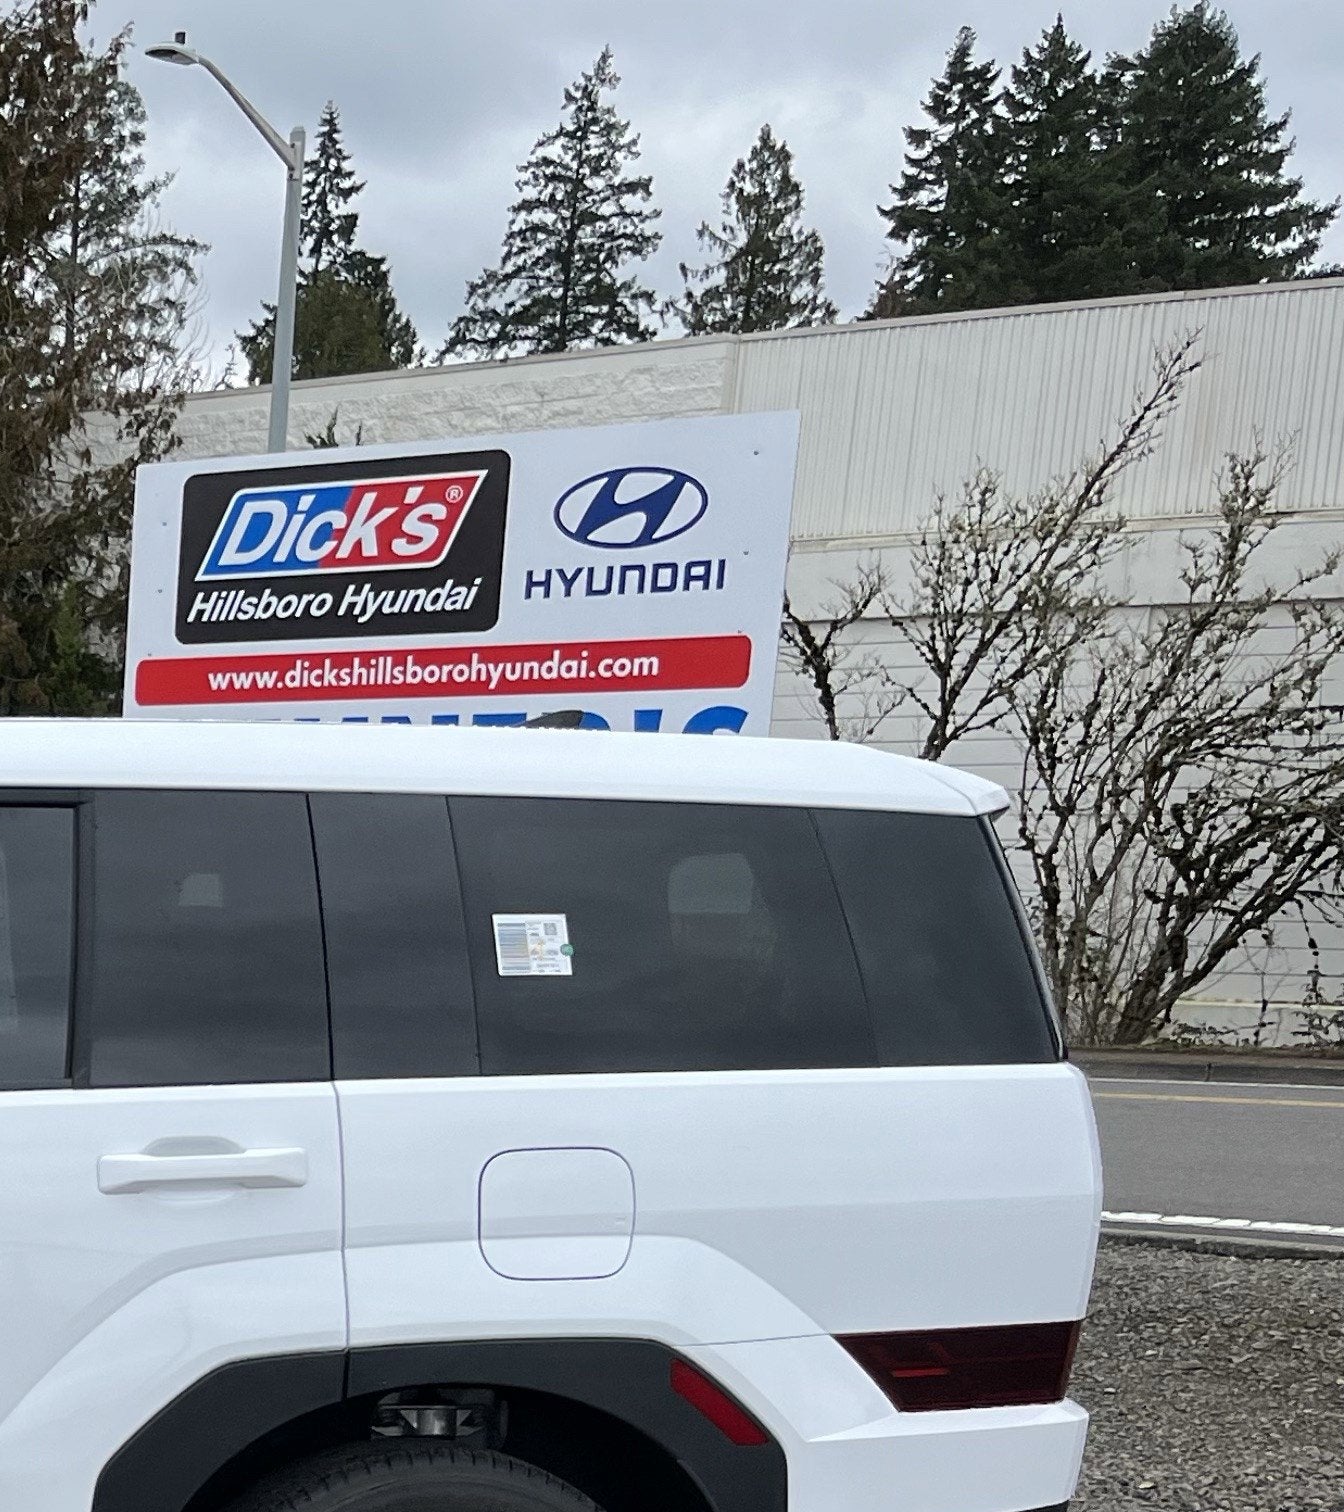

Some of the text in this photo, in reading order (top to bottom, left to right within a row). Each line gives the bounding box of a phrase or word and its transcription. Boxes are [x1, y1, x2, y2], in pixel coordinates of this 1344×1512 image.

[217, 485, 448, 567] Dick's
[186, 577, 482, 624] Hillsboro Hyundai
[523, 558, 727, 601] HYUNDAI
[207, 648, 660, 691] www.dickshillsborohyundai.com
